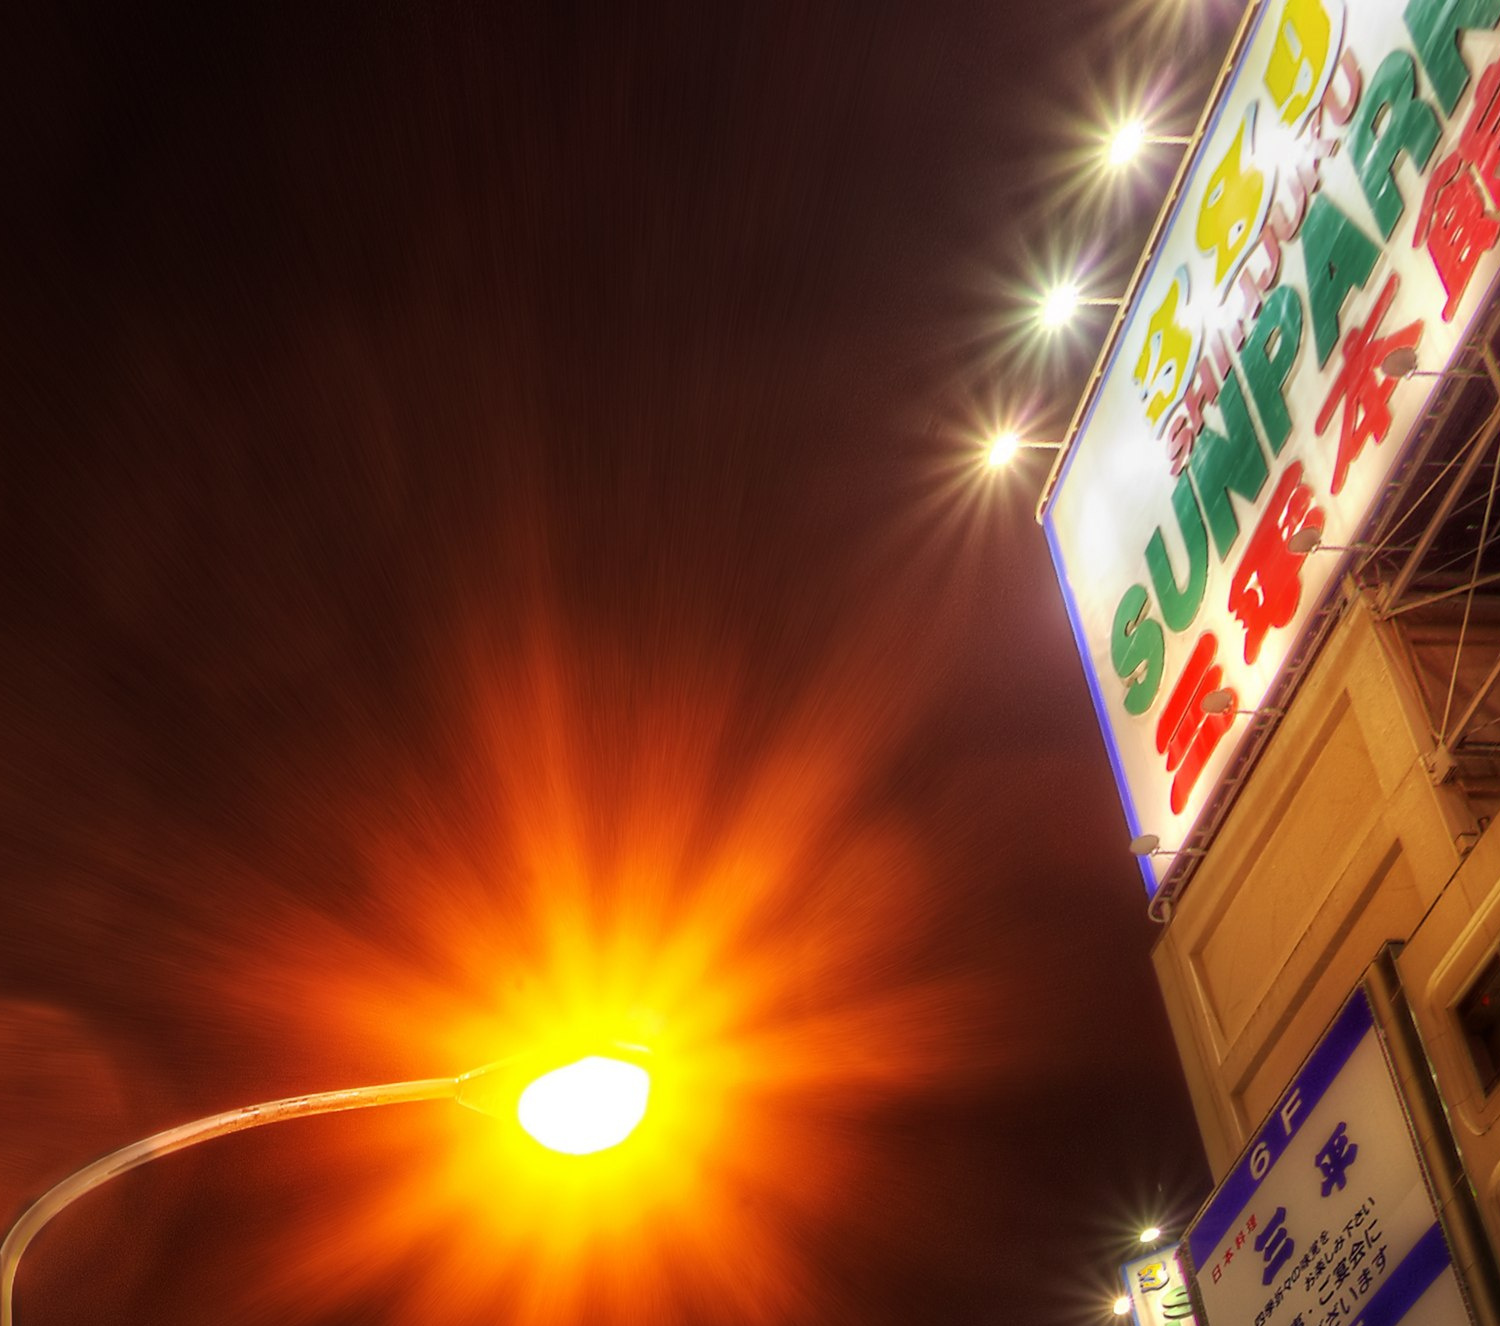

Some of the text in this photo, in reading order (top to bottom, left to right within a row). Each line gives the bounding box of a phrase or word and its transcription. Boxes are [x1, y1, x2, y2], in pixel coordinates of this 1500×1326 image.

[1209, 1214, 1260, 1285] 日本料理
[1253, 1122, 1360, 1288] 三平
[1302, 1196, 1377, 1292] お楽しみ下さい
